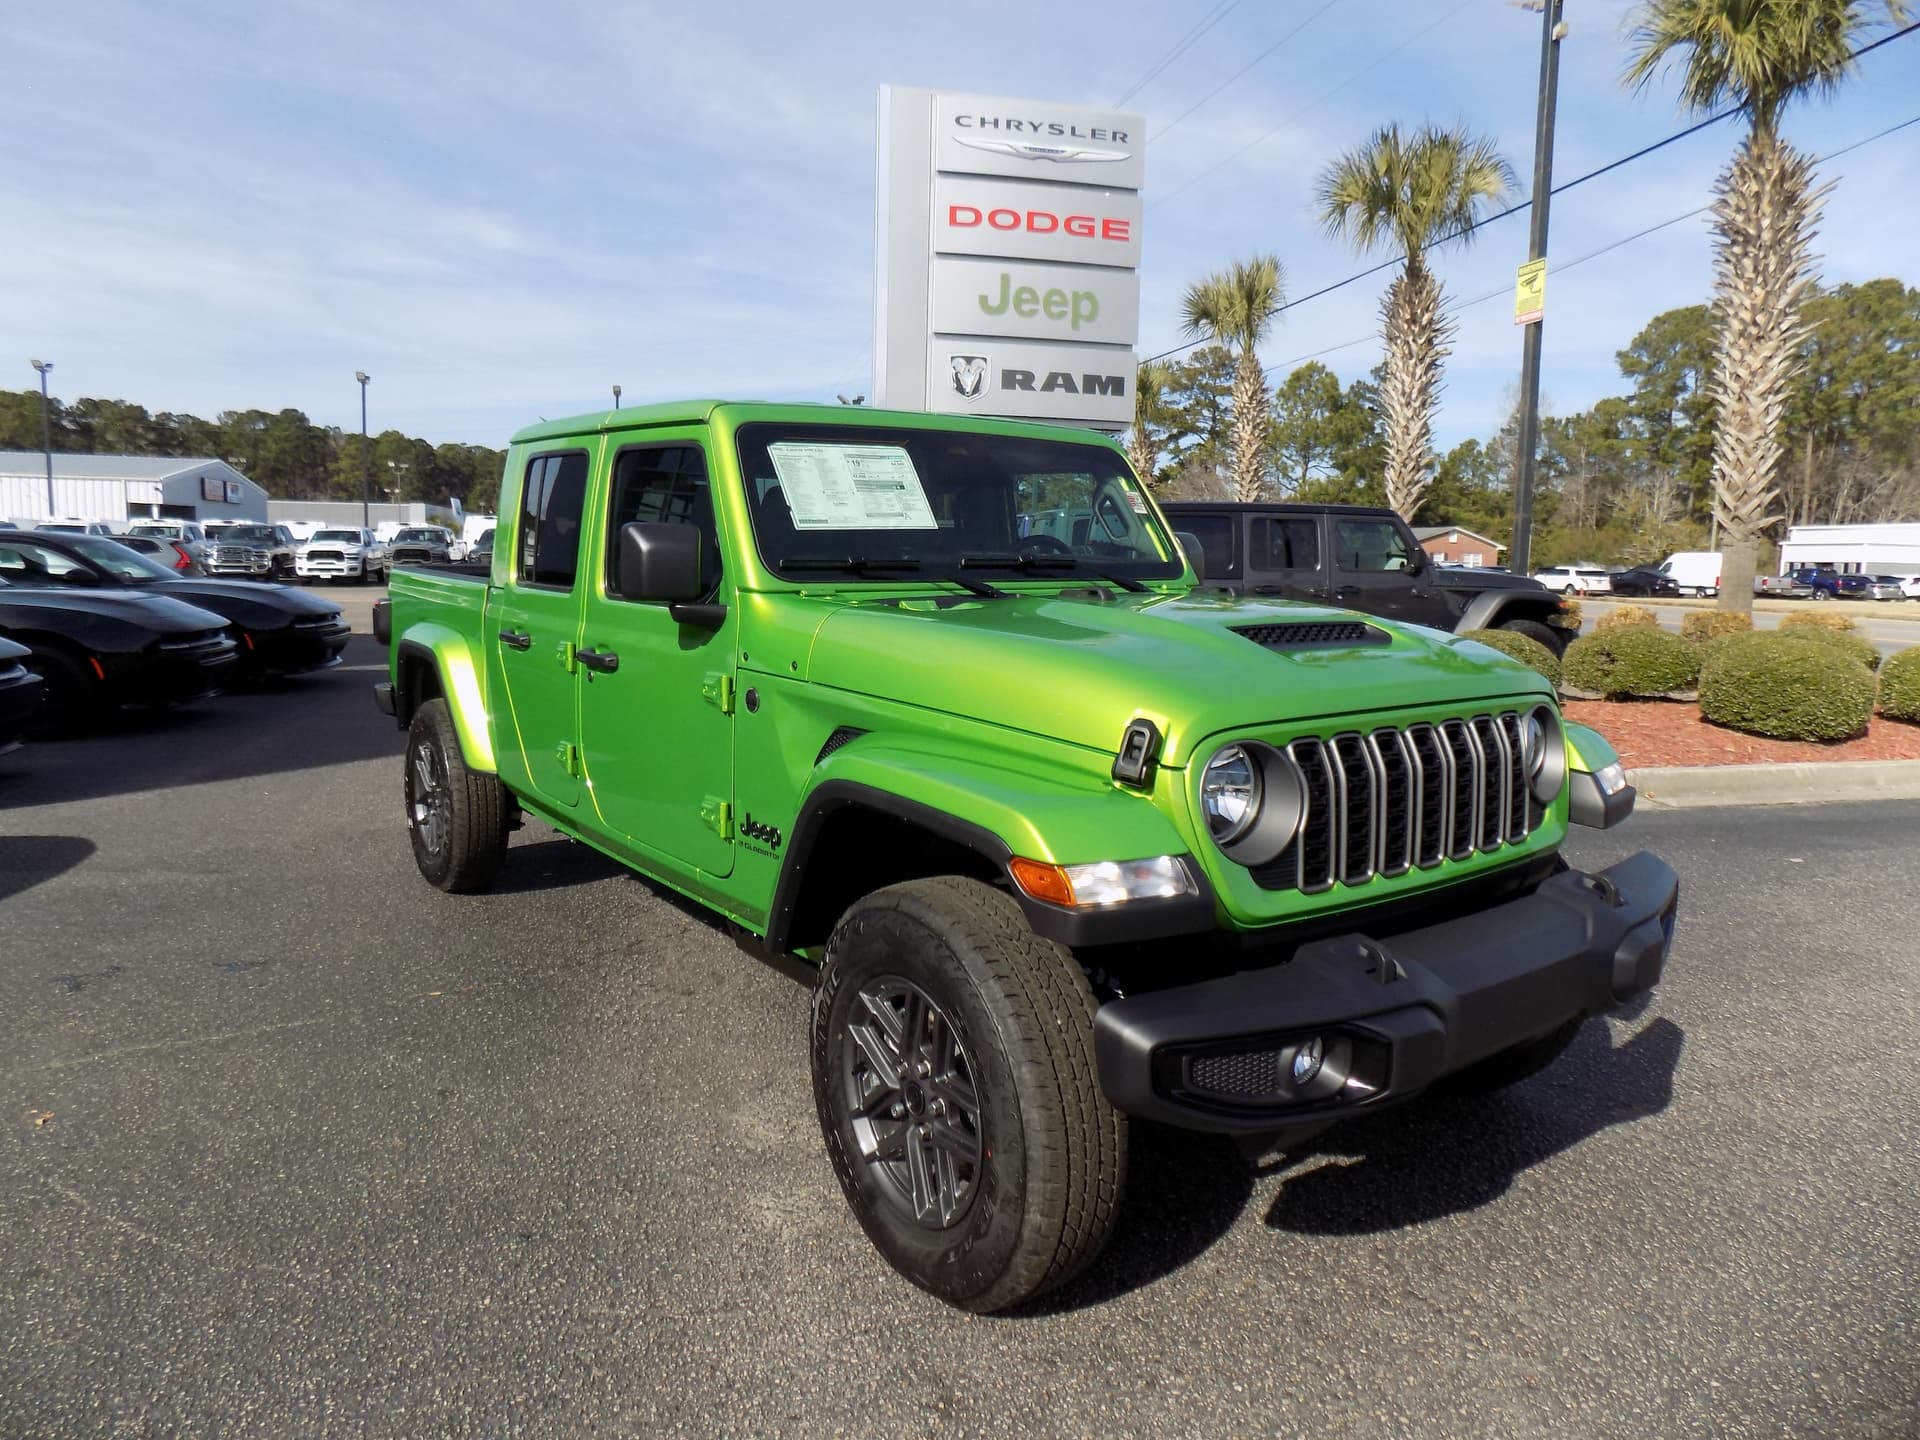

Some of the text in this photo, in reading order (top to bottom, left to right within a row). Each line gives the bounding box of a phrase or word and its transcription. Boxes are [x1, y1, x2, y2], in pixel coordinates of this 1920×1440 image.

[954, 114, 1130, 144] CHRYSLER
[949, 205, 1131, 243] DODGE
[978, 273, 1100, 331] Jeep
[1001, 368, 1125, 397] RAM
[740, 812, 781, 850] Jeep
